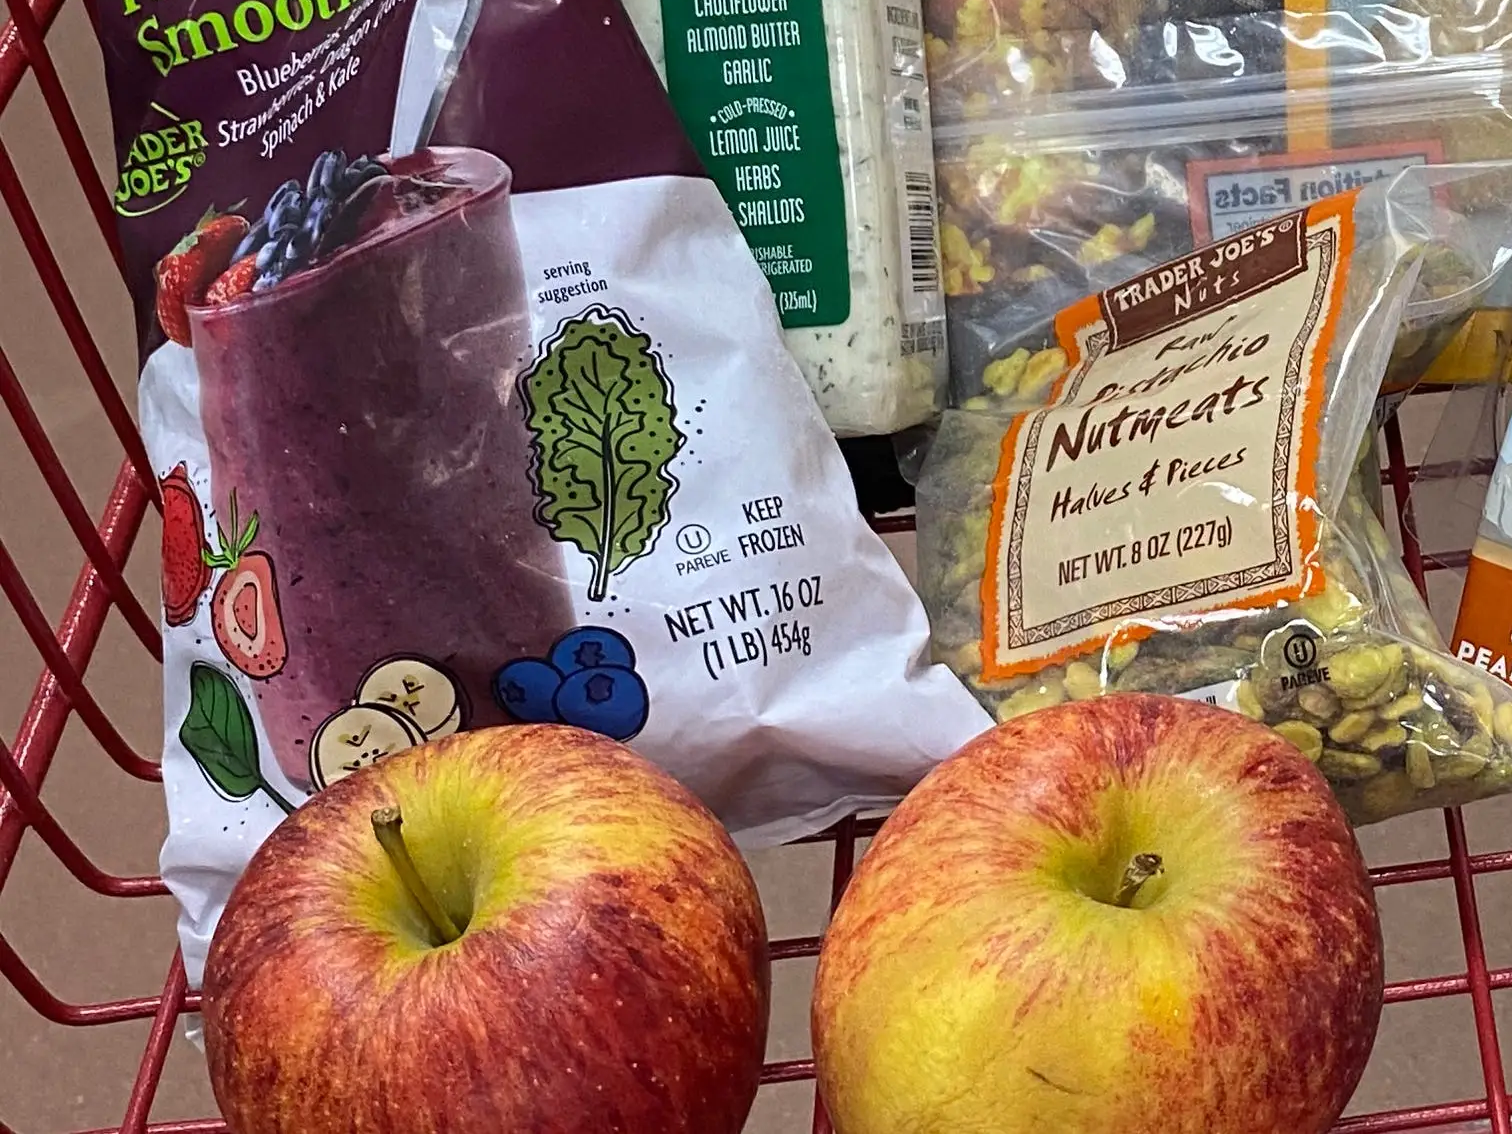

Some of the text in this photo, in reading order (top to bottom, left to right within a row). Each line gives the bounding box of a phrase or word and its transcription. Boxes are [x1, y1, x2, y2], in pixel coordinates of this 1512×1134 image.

[687, 21, 801, 53] ALMOND BUTTER
[723, 58, 772, 85] GARLIC
[259, 53, 362, 160] Spinach & Kale
[717, 97, 787, 124] COLD-PRESSED
[710, 125, 801, 157] LEMON JUICE
[736, 165, 781, 191] HERBS
[739, 198, 804, 227] SHALLOTS
[543, 260, 592, 281] serving
[1114, 256, 1202, 311] TRADER
[538, 277, 608, 304] suggestion
[779, 289, 818, 313] (325mL)
[1174, 271, 1242, 317] Nuts
[1155, 315, 1236, 360] Raw
[1046, 375, 1268, 472] Nutmeats
[1051, 481, 1131, 522] Halves
[1166, 446, 1246, 484] Pieces
[742, 496, 784, 525] KEEP
[737, 524, 804, 558] FROZEN
[1058, 520, 1233, 586] NET WT. 8 OZ (227g)
[675, 549, 731, 576] PAREVE
[664, 576, 824, 642] NET WT. 16 OZ
[703, 621, 812, 680] (1 LB) 454g
[1280, 666, 1330, 690] PAREVE
